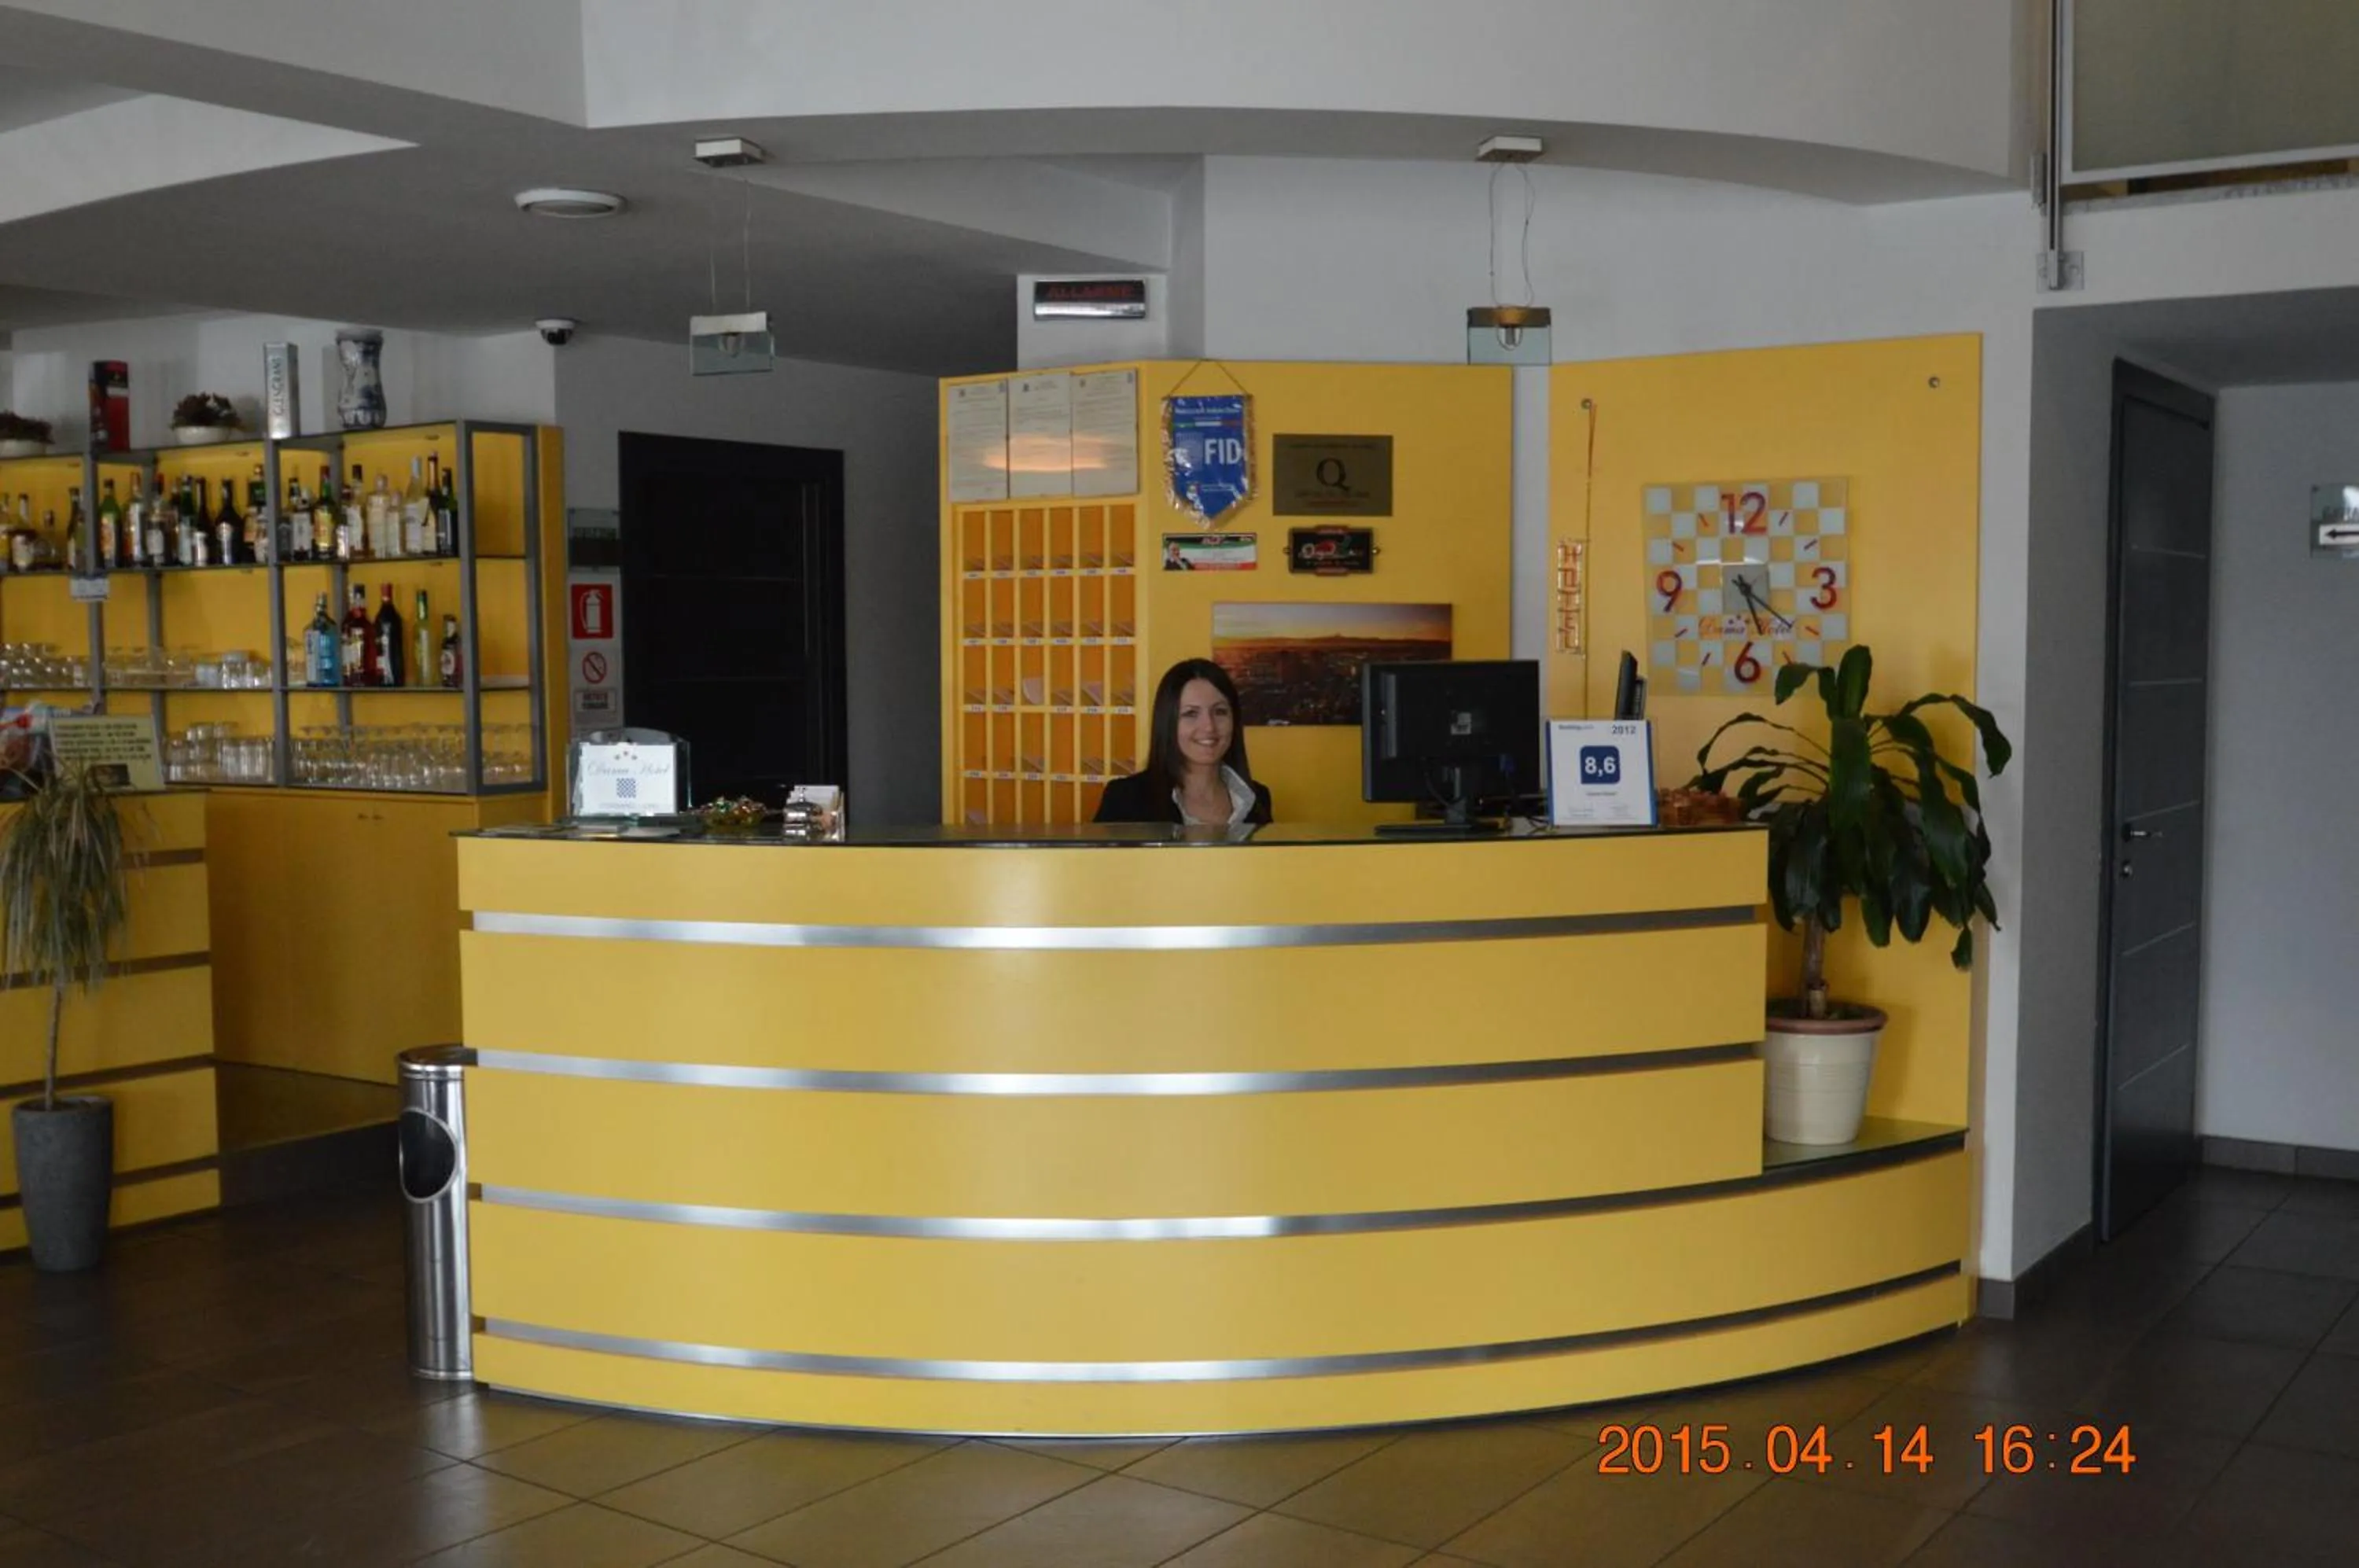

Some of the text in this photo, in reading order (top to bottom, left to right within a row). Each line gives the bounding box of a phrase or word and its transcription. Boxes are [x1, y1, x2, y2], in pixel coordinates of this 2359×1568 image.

[1204, 438, 1242, 465] FID
[1316, 457, 1352, 491] Q
[1720, 491, 1768, 535] 12
[1656, 570, 1683, 613] 9
[1810, 567, 1838, 609] 3
[1734, 641, 1761, 683] 6
[1611, 724, 1636, 735] 2012
[1584, 756, 1617, 777] 8,6
